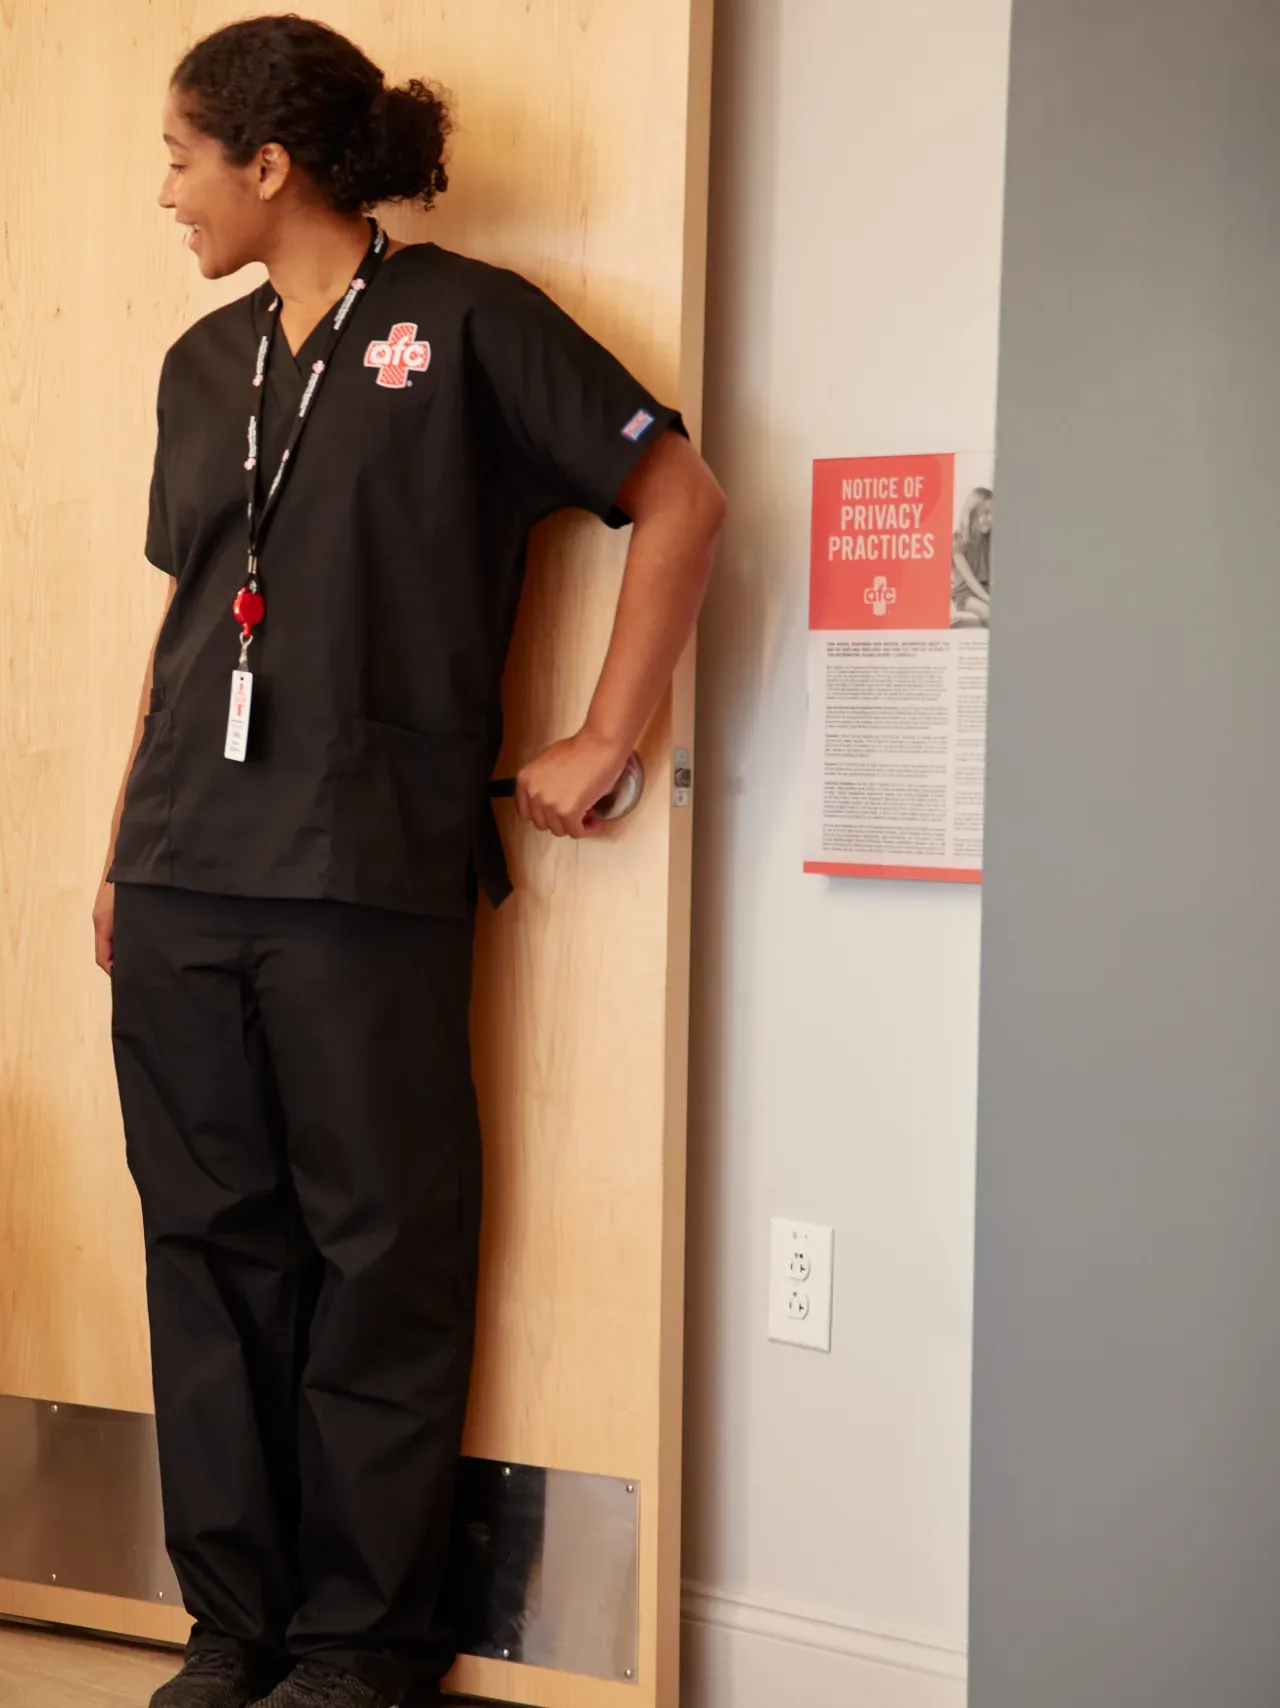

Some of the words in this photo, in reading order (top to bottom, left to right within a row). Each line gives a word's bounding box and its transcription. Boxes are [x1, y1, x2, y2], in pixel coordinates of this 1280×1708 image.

[369, 336, 425, 367] afc
[842, 478, 898, 500] NOTICE
[904, 476, 924, 498] OF
[841, 504, 924, 530] PRIVACY
[828, 533, 935, 561] PRACTICES
[865, 584, 895, 603] afc
